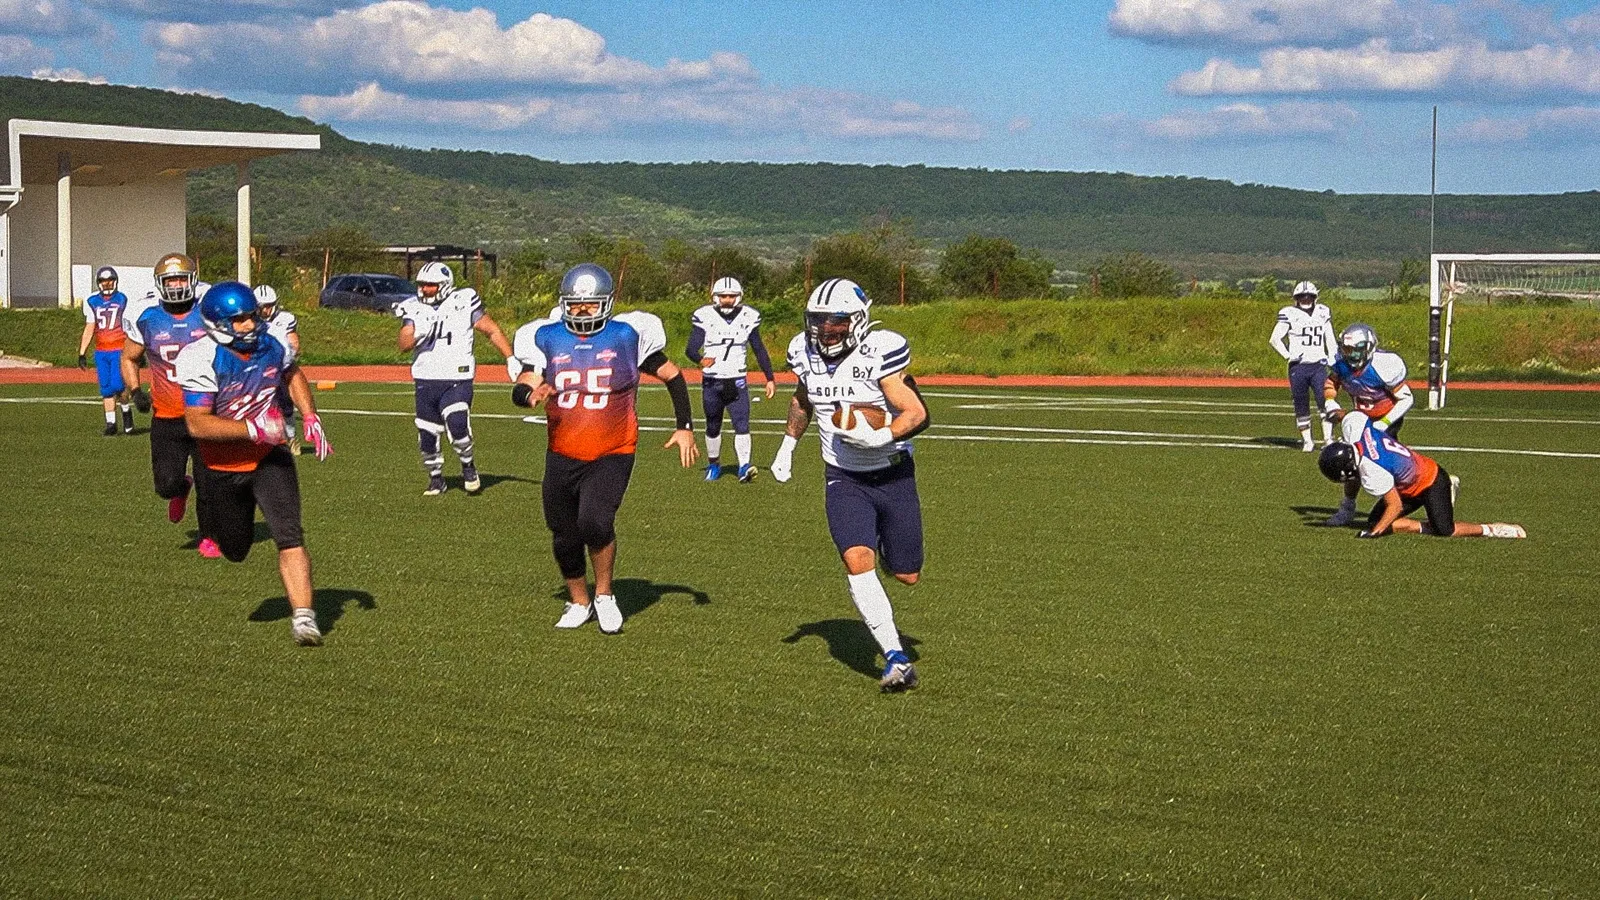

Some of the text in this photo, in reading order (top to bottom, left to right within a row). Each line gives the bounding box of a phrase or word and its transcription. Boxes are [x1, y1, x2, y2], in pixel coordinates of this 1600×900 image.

[96, 306, 119, 330] 57
[1301, 325, 1323, 347] 55
[721, 337, 735, 362] 7
[554, 367, 613, 410] 65
[816, 386, 855, 398] SOFIA
